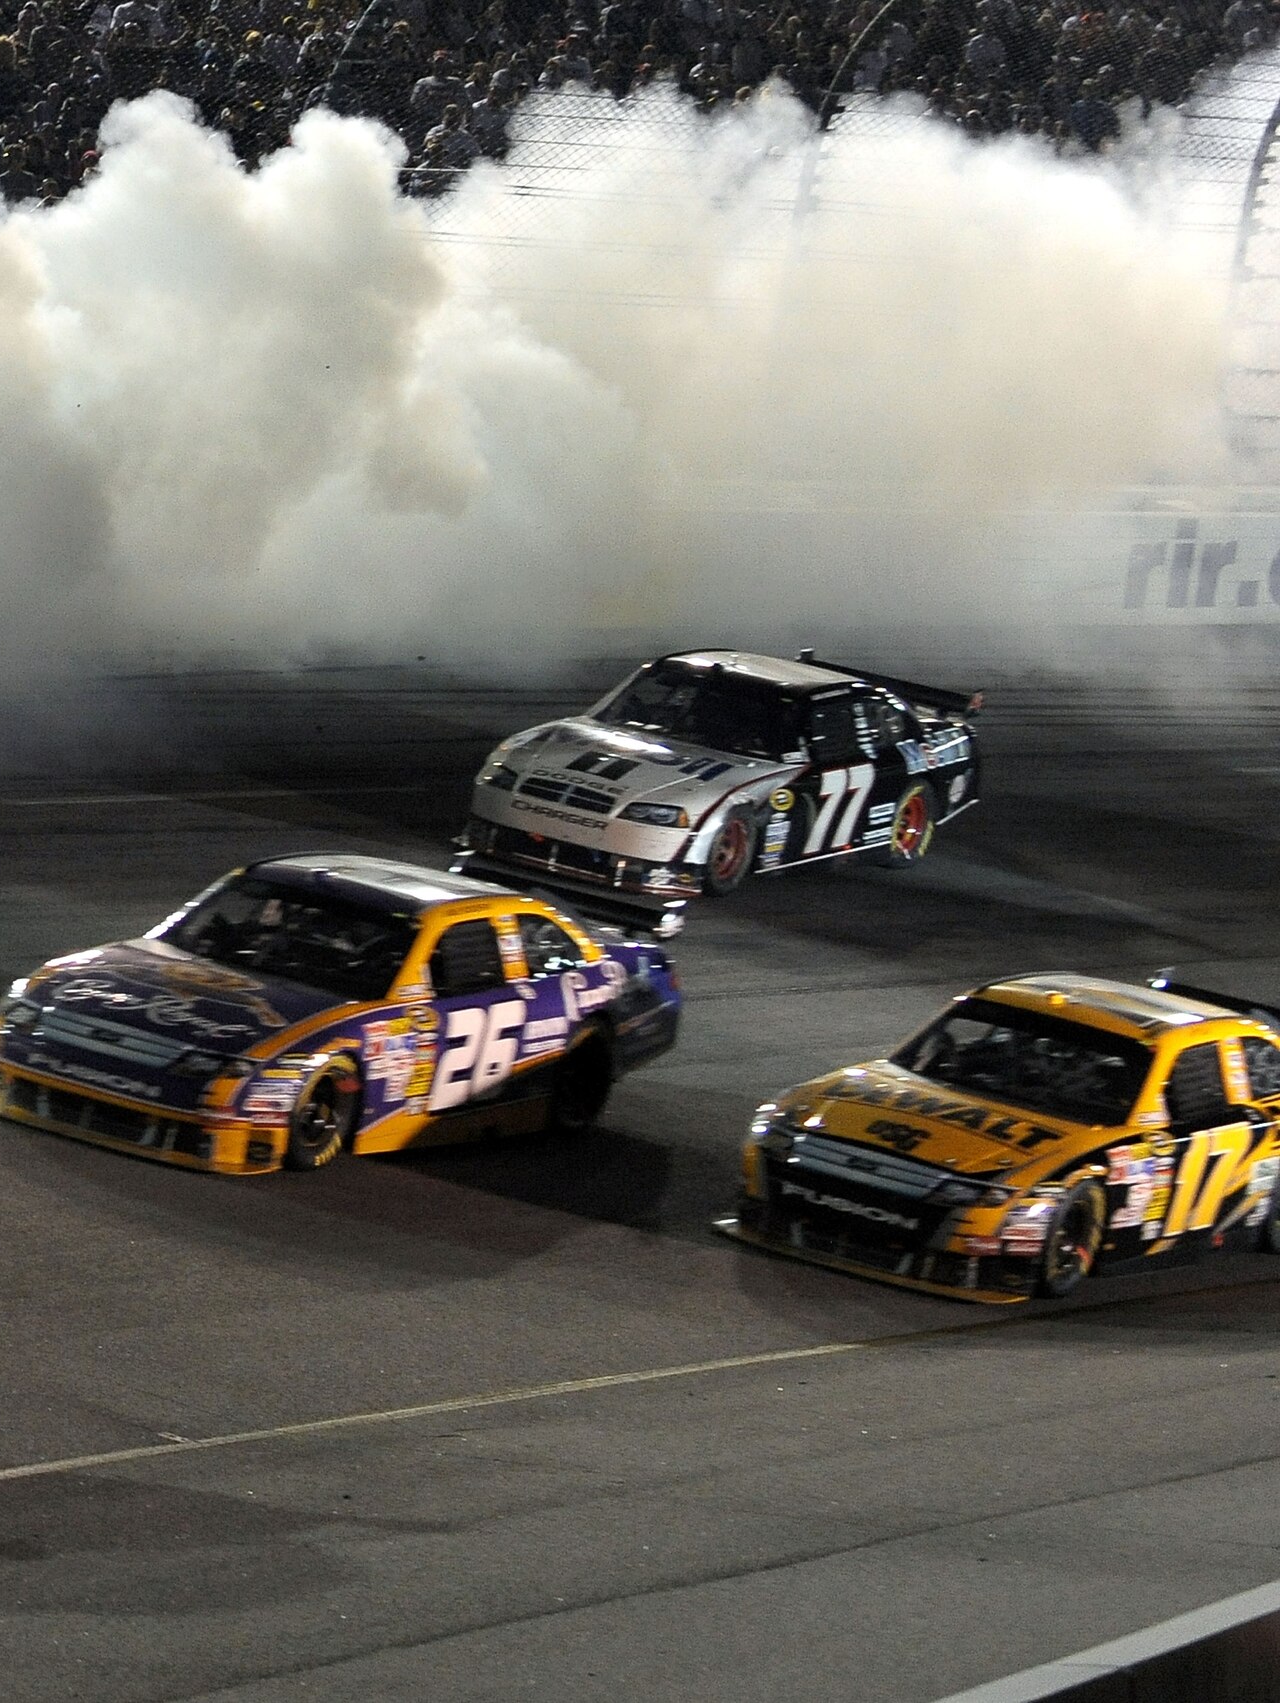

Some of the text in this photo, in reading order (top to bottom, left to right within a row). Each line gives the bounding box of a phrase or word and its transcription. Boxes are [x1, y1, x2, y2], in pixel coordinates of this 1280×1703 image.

[510, 799, 609, 831] CHARGER
[802, 763, 877, 854] 77
[427, 1000, 527, 1112] 26
[1162, 1120, 1253, 1239] 17
